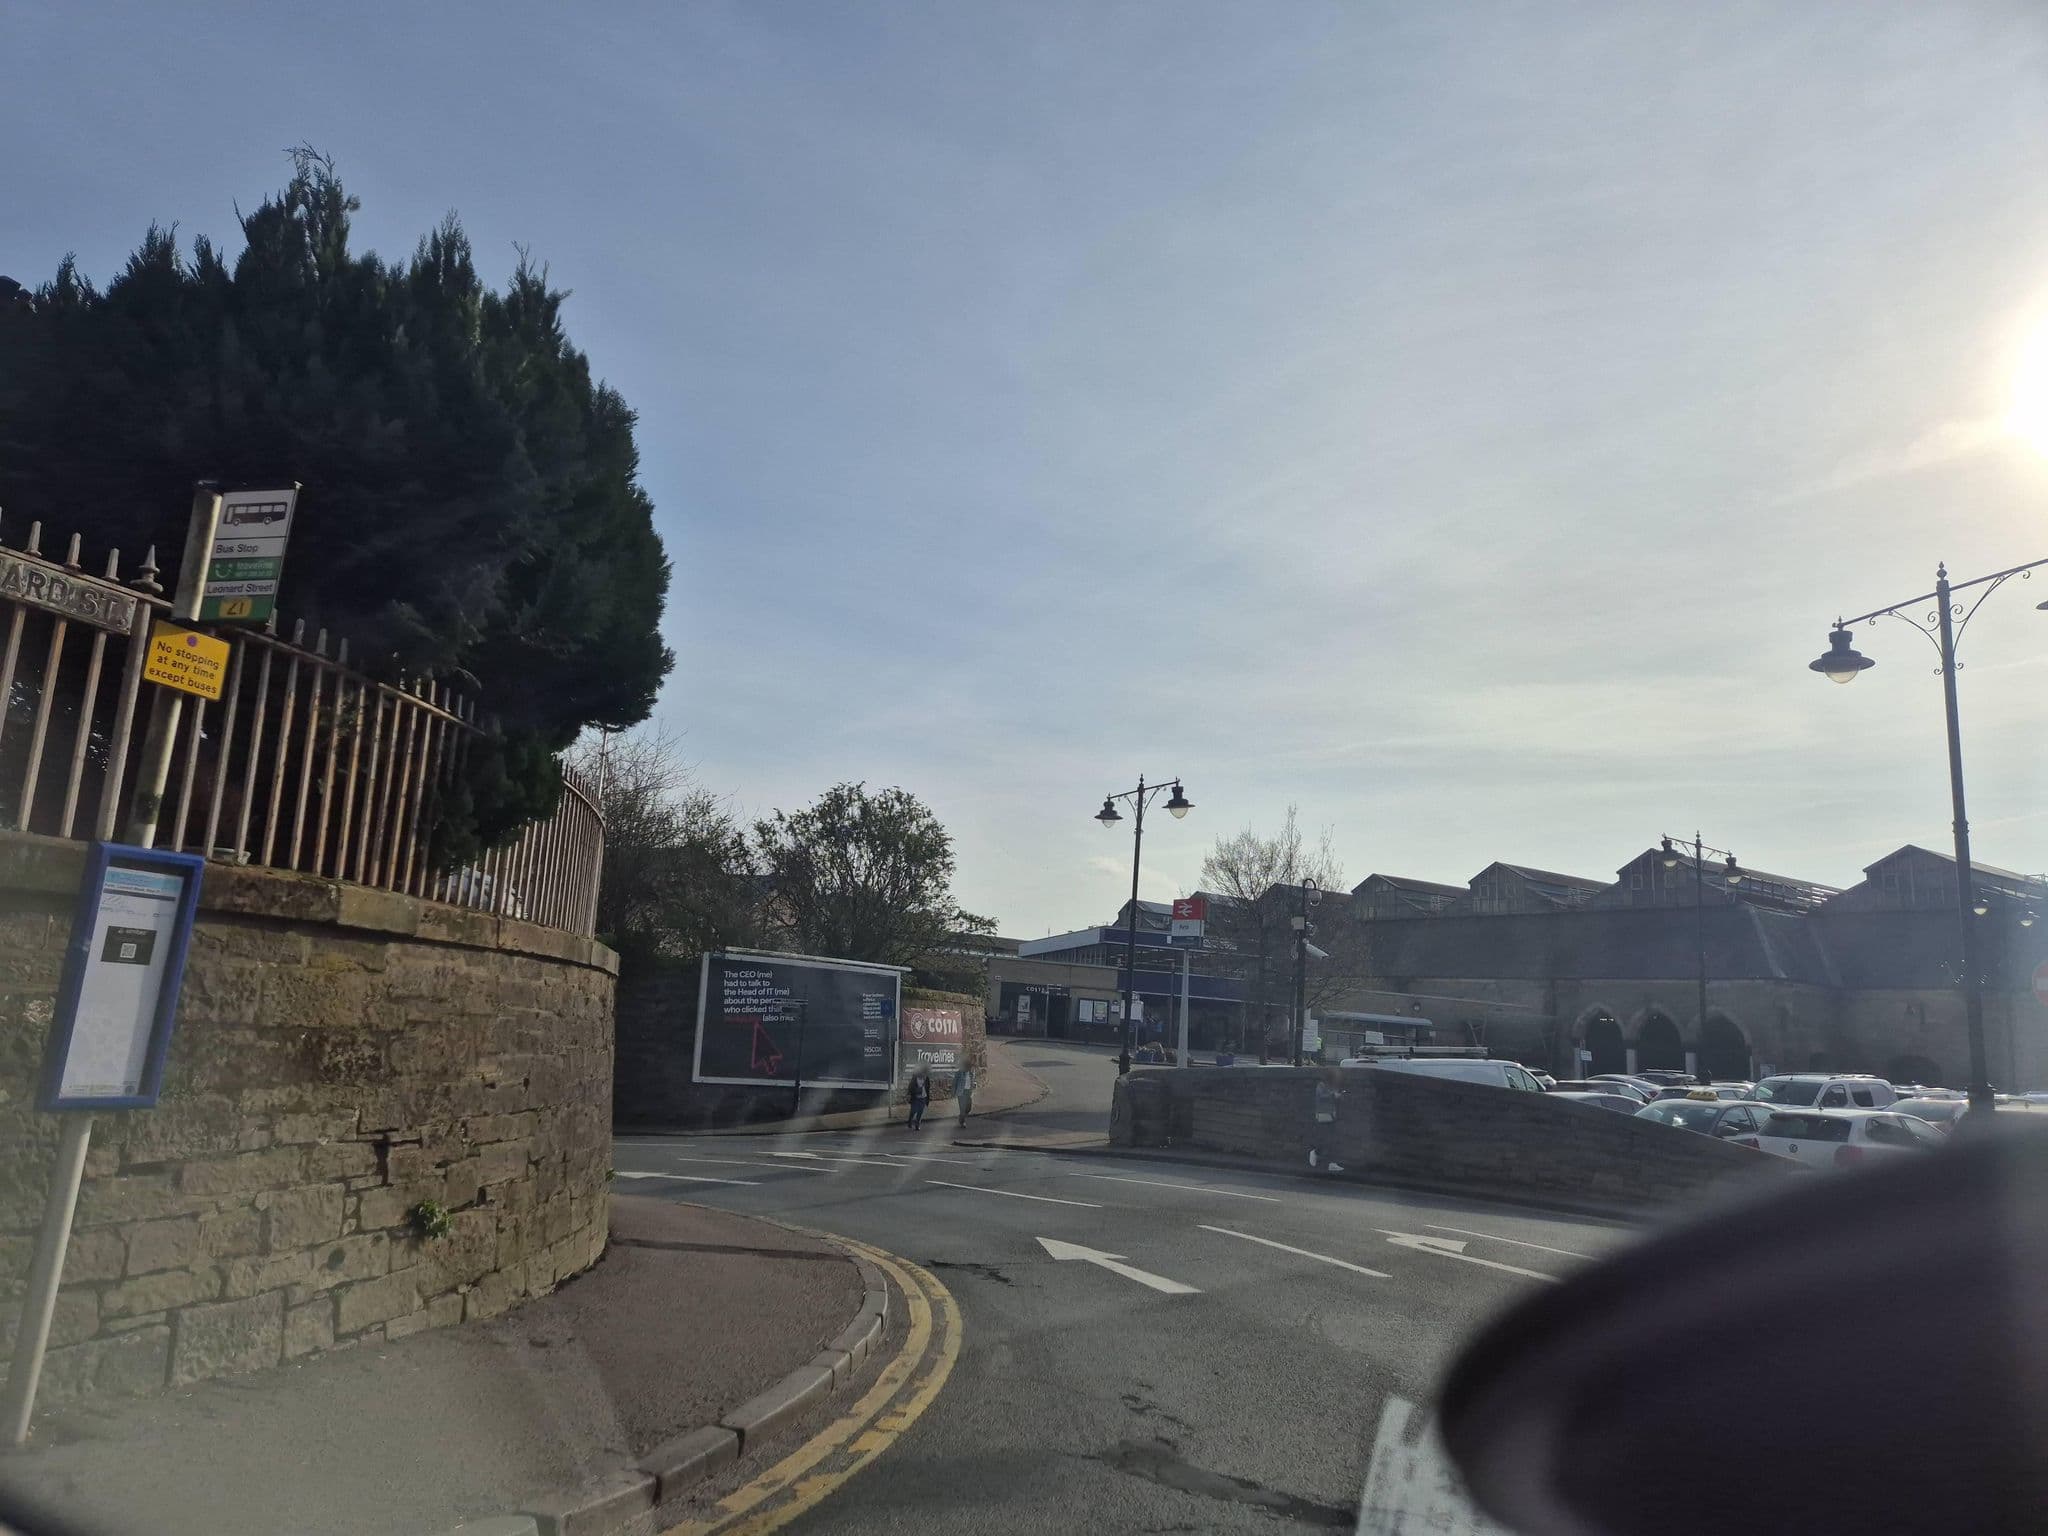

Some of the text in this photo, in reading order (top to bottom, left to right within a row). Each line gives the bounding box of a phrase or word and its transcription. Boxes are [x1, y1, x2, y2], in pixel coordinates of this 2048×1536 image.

[216, 543, 259, 554] Bus Stop
[0, 559, 70, 606] ARD
[207, 582, 273, 595] Leonard Street
[157, 641, 219, 670] No stopping
[157, 656, 215, 679] at any time
[149, 668, 217, 693] except buses
[757, 971, 773, 979] (me)
[724, 988, 790, 996] the Head of IT (me)
[724, 997, 746, 1005] about
[747, 997, 759, 1005] the
[724, 1005, 783, 1013] who clicked that
[763, 1014, 779, 1022] (also
[928, 1017, 958, 1036] COSTA
